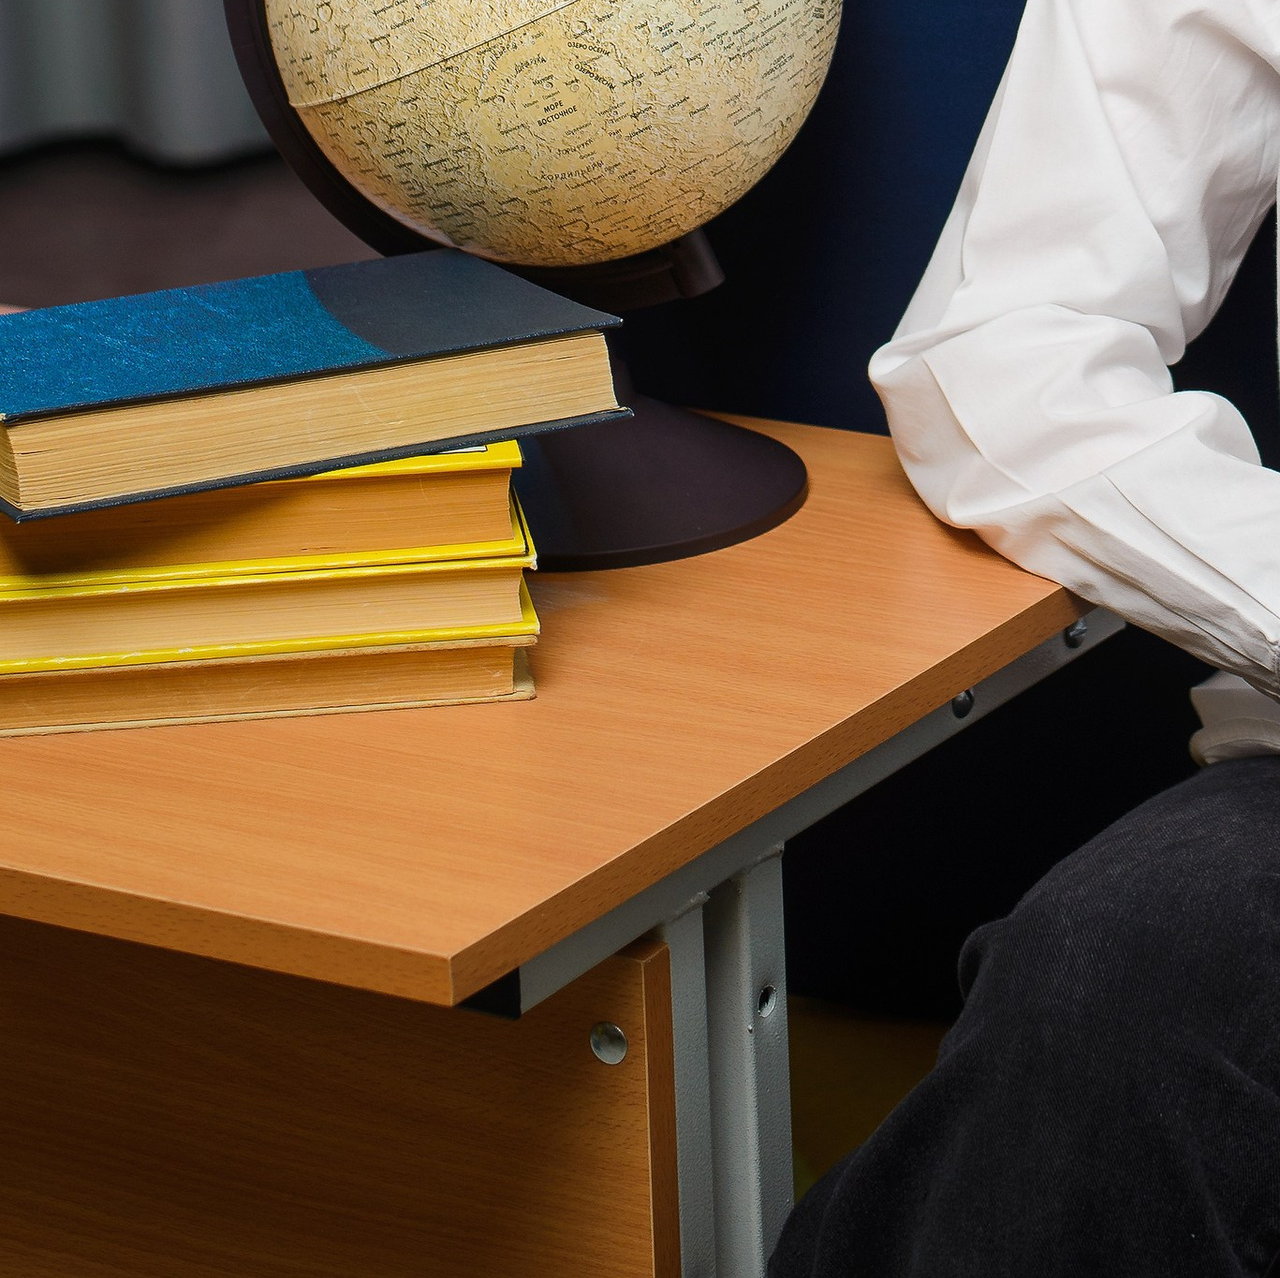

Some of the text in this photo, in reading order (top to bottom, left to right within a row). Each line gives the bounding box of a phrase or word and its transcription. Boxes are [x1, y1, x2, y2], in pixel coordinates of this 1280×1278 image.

[567, 41, 612, 57] ОЗЕРО ОСЕНИ
[574, 63, 617, 92] ОЗЕРО ВЕСНЫ
[537, 104, 579, 127] ВОСТОЧНОЕ
[543, 99, 564, 114] МОРЕ
